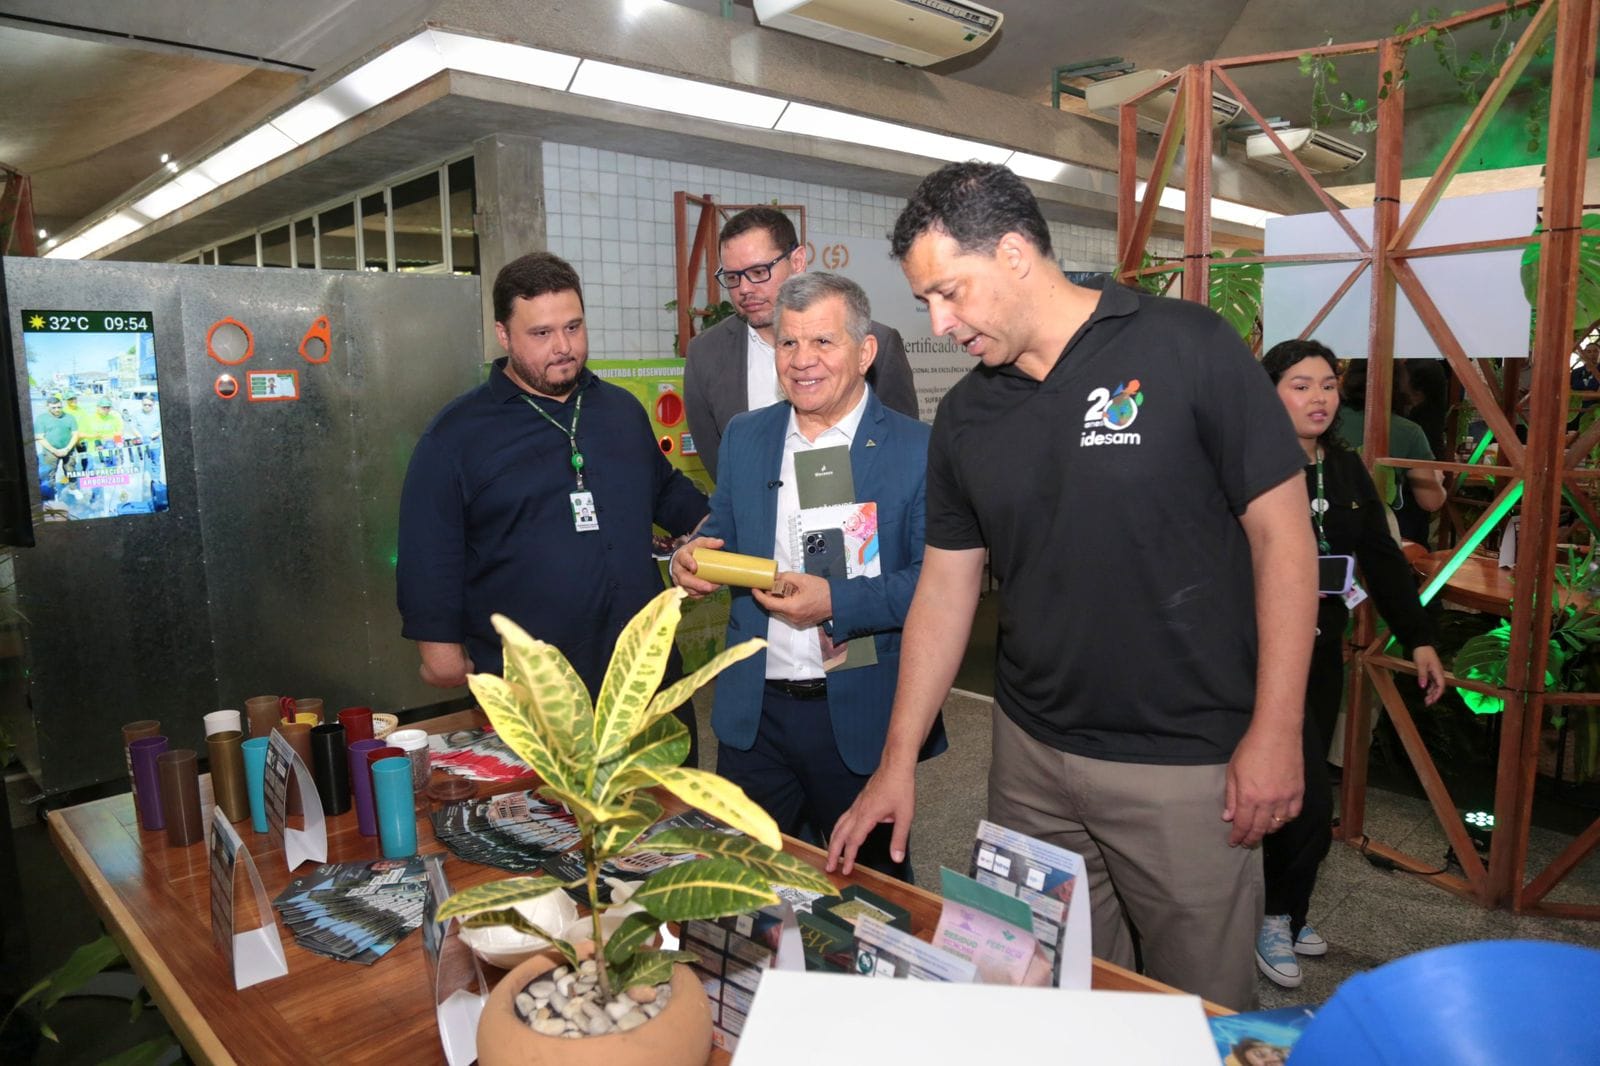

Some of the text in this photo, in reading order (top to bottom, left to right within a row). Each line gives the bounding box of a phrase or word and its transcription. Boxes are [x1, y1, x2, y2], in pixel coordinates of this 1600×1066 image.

[49, 315, 148, 330] 32°C 09:54
[904, 337, 959, 353] ertificado
[1080, 431, 1141, 447] idesam
